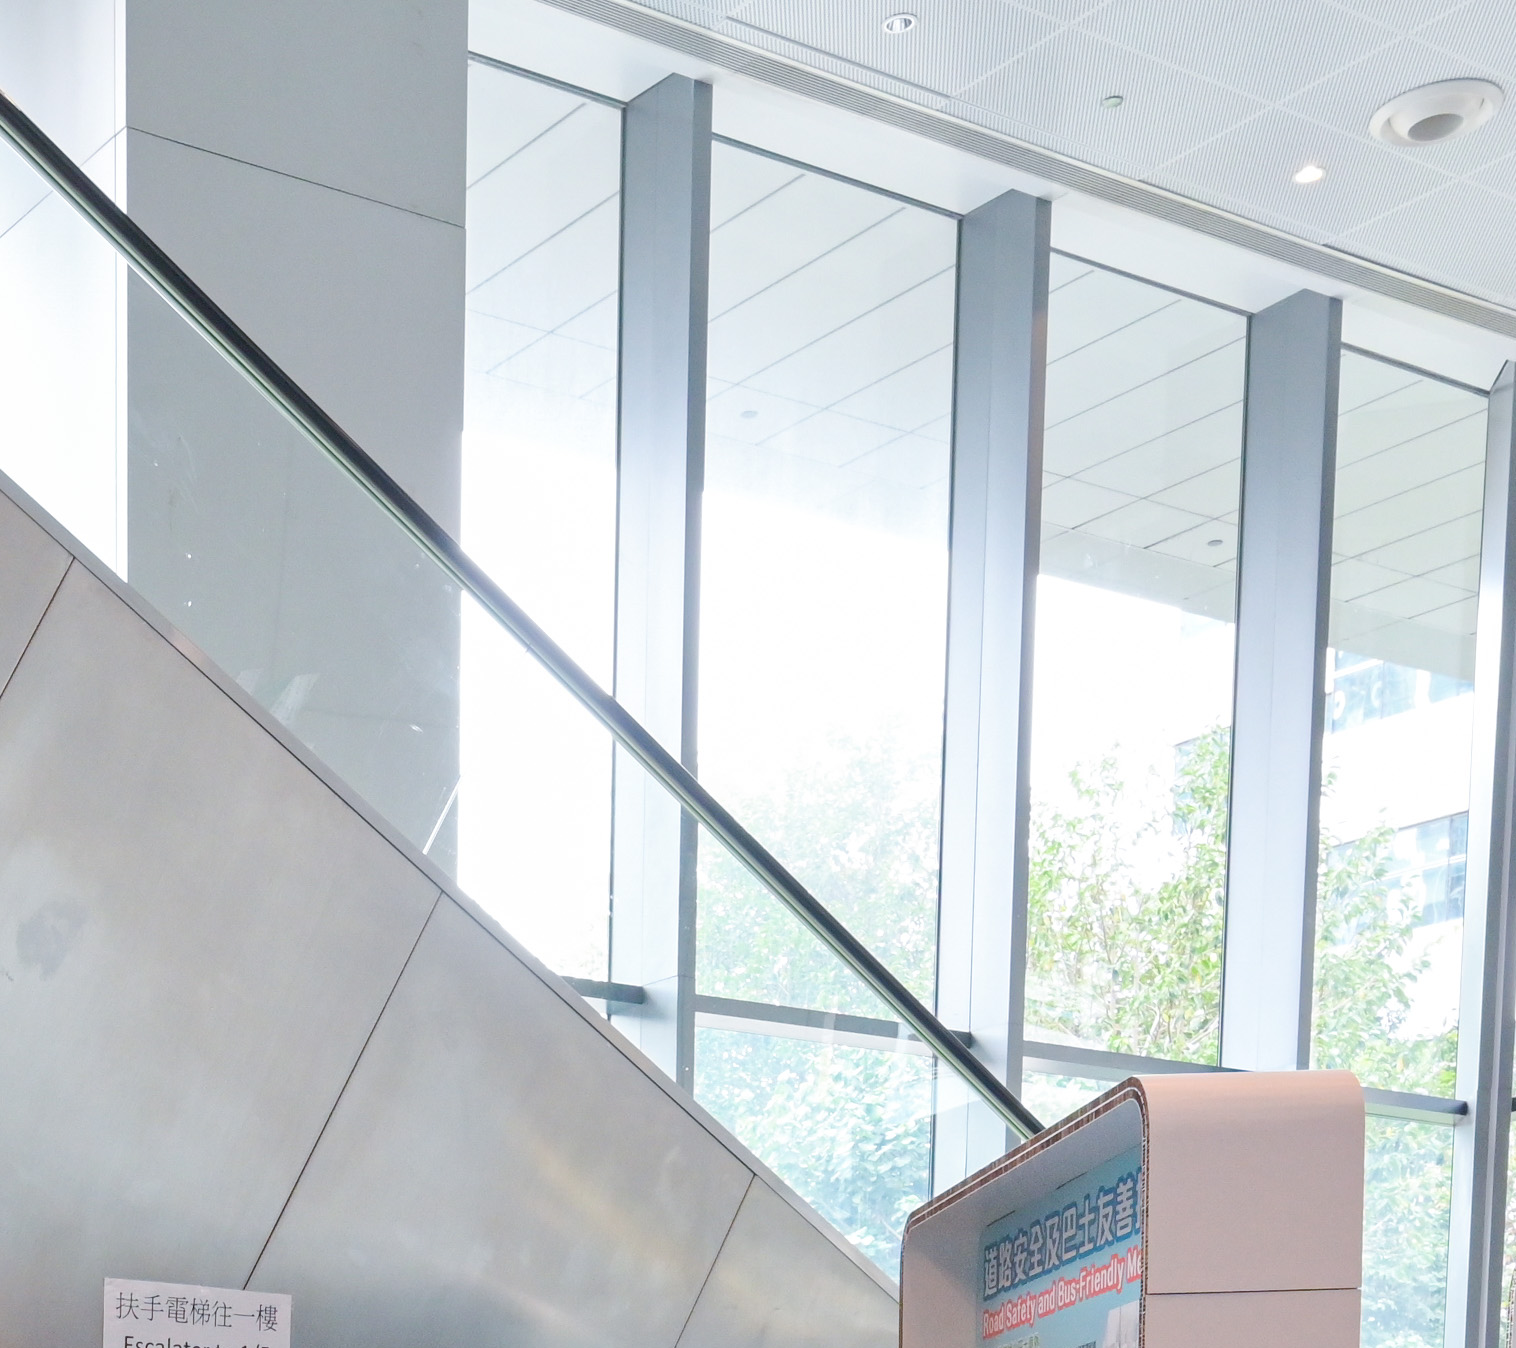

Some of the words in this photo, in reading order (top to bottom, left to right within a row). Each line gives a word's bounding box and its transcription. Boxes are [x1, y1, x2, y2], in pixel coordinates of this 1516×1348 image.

[115, 1292, 279, 1332] 扶手電梯往一樓
[983, 1306, 1004, 1336] Road
[1006, 1297, 1036, 1327] Safety
[1038, 1291, 1054, 1316] and
